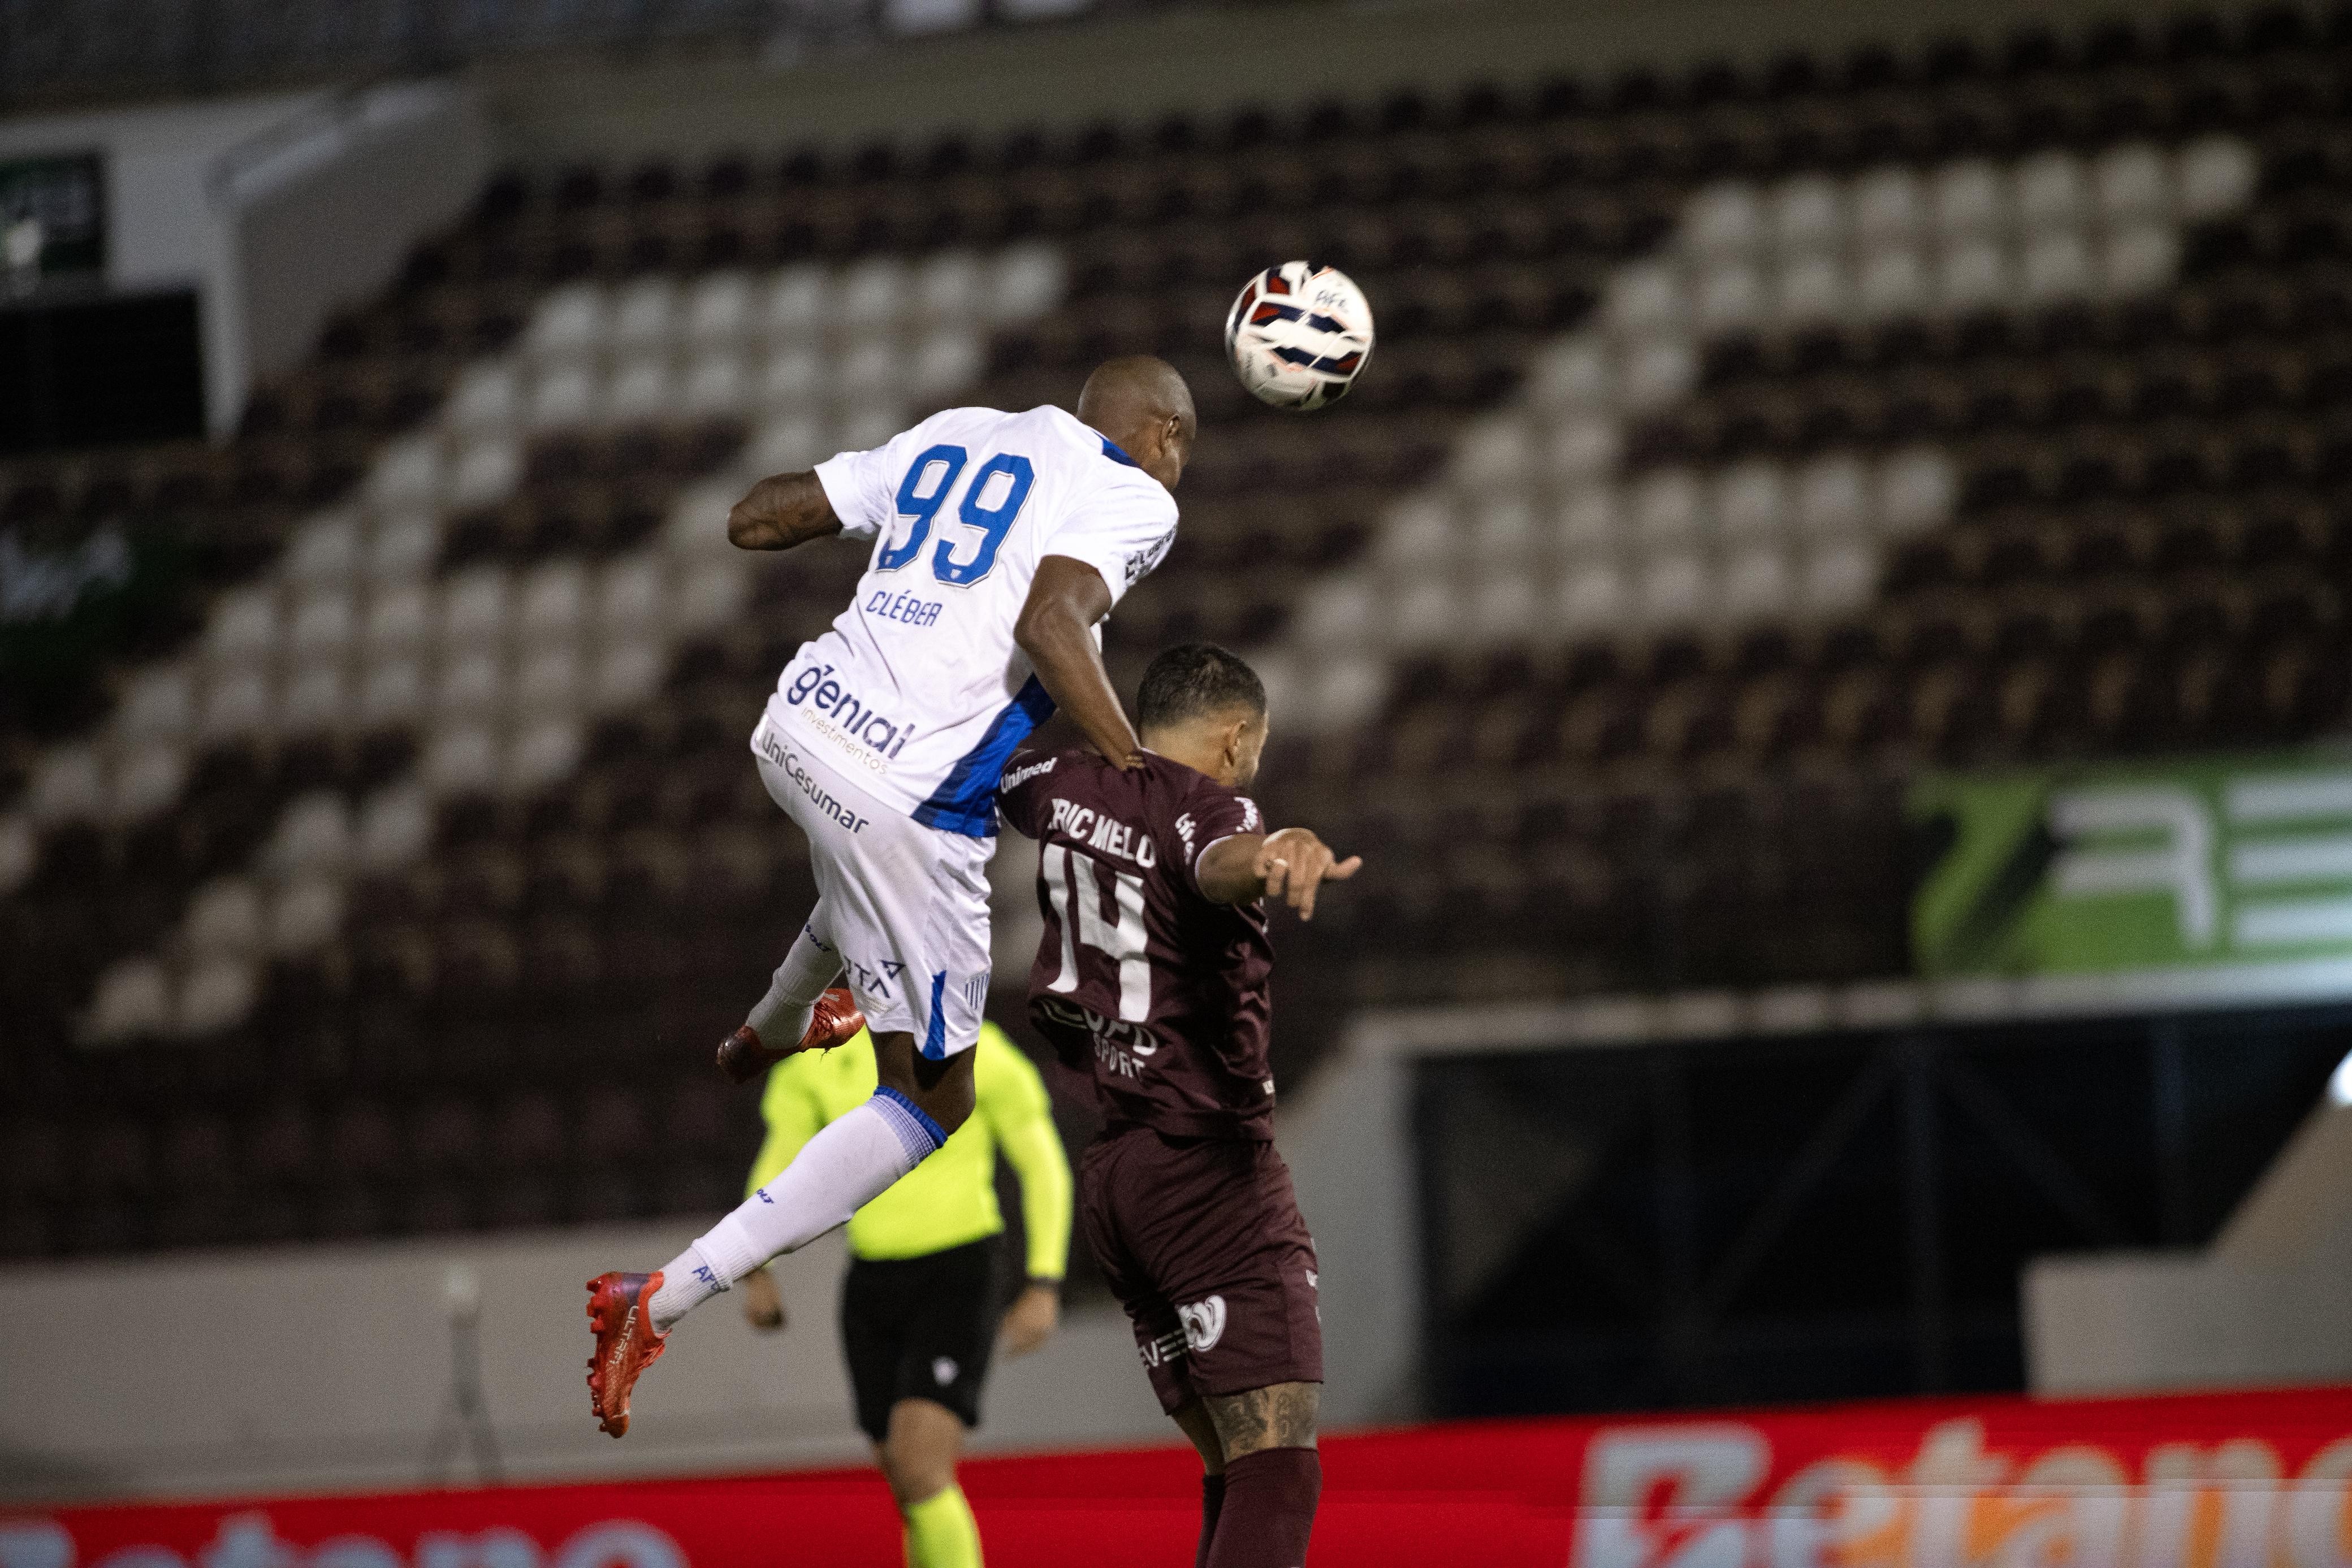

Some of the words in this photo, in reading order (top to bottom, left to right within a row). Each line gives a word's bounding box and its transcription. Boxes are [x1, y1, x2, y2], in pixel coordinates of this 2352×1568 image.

[875, 443, 1037, 589] 99
[865, 589, 943, 627] CLÉBER
[801, 707, 888, 775] investimentos
[762, 731, 869, 834] UniCesumar
[1000, 756, 1058, 794] Unimed
[1087, 814, 1156, 869] MELO
[1043, 843, 1152, 1023] 14
[1092, 1032, 1146, 1078] SPORT
